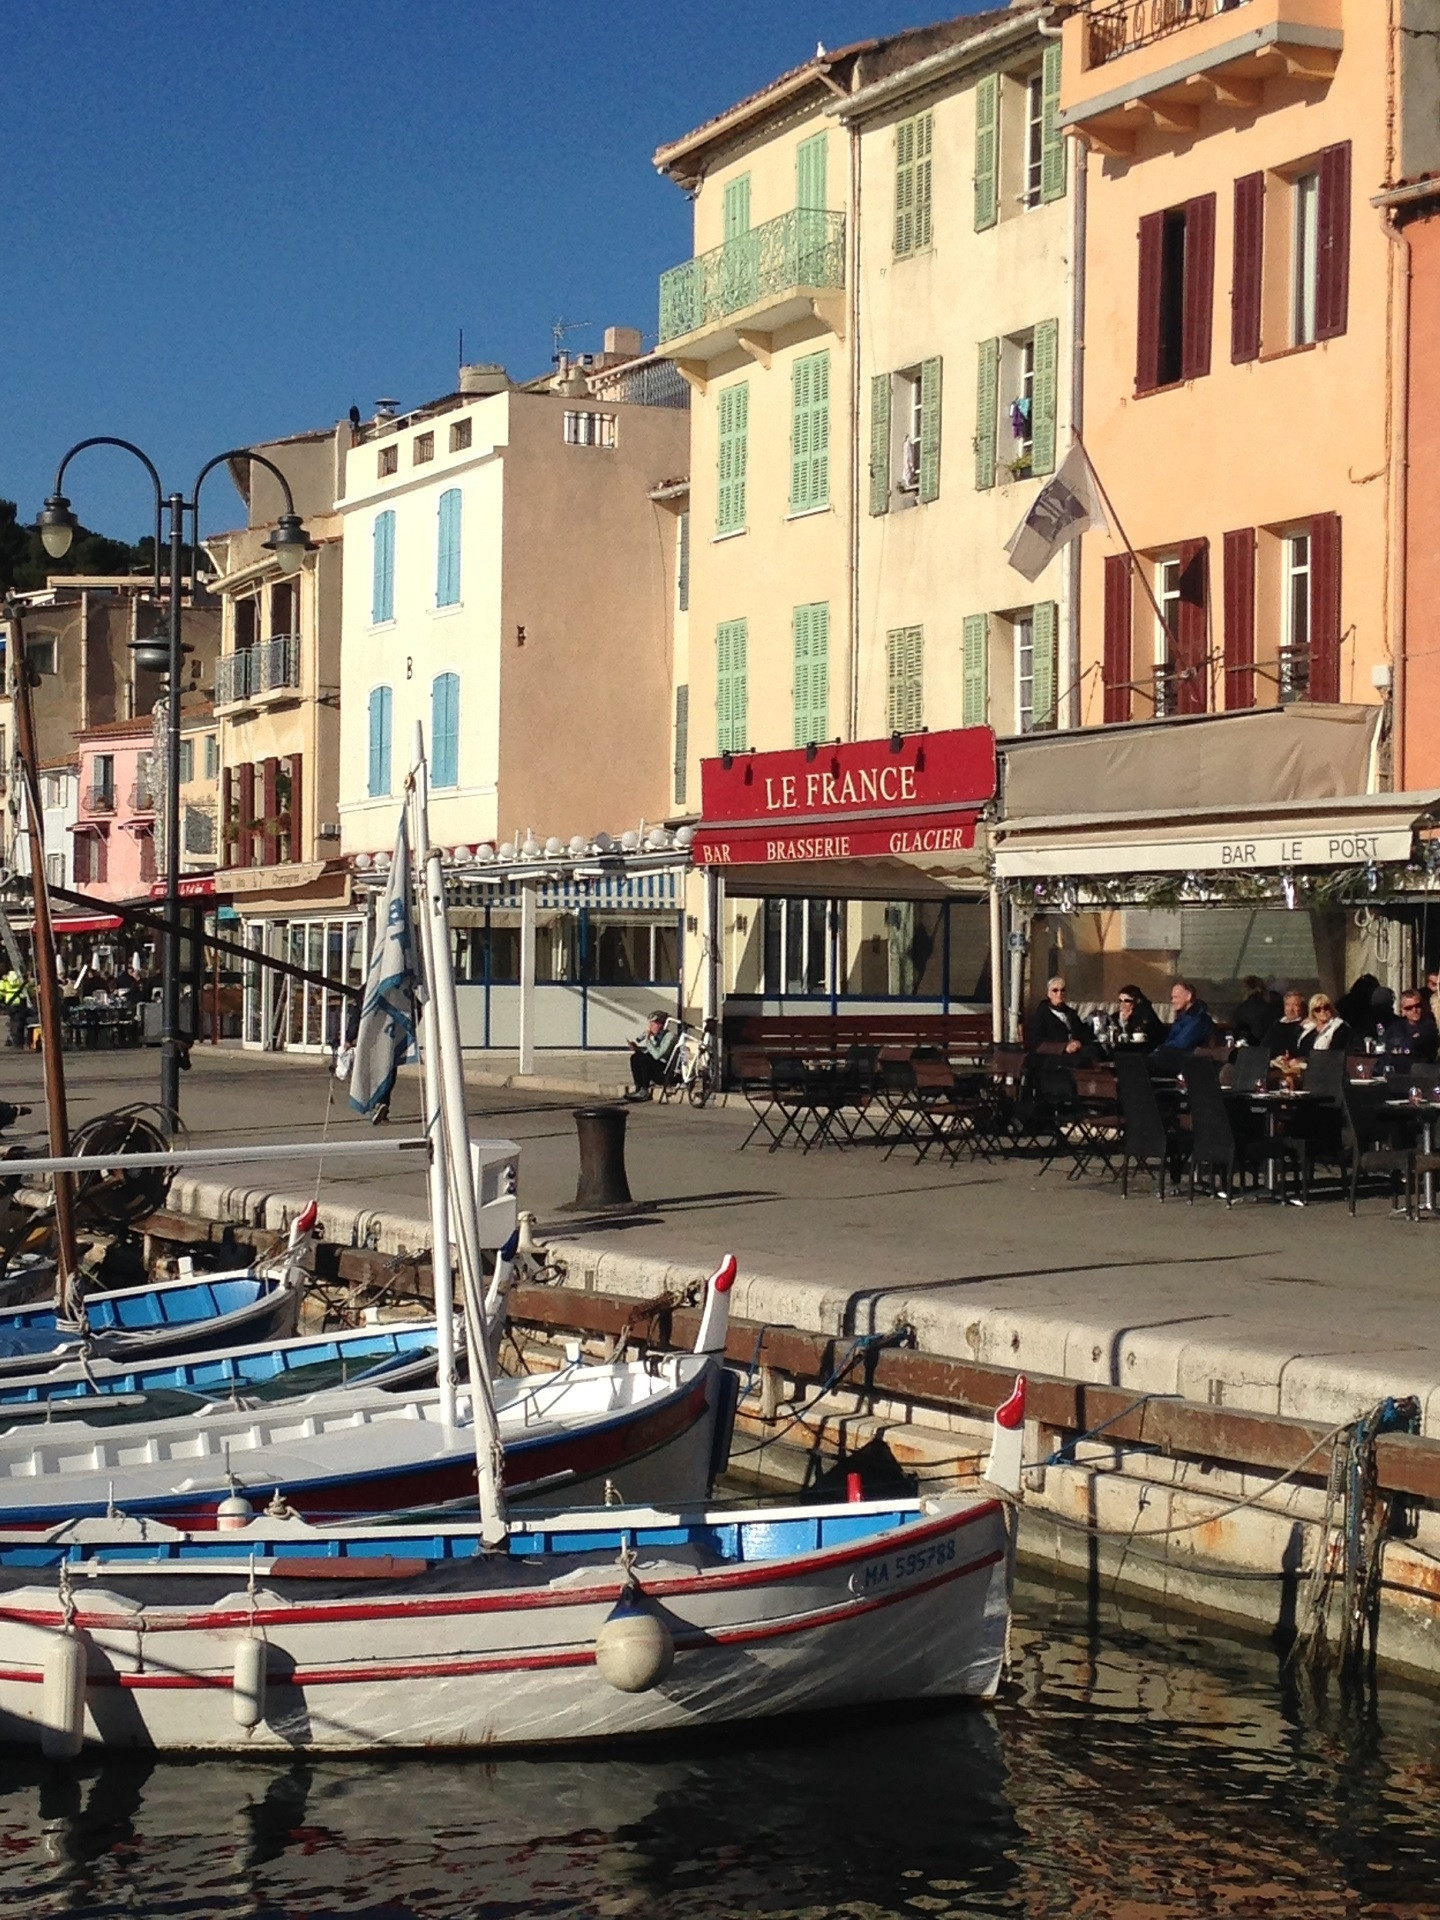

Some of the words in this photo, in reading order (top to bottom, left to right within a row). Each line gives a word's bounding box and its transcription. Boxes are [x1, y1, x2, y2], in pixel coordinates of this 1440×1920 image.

[765, 775, 797, 810] LE
[805, 765, 917, 807] FRANCE
[703, 844, 731, 863] BAR
[766, 836, 850, 861] BRASSERIE
[889, 828, 963, 853] GLACIER
[1221, 844, 1256, 865] BAR
[1281, 841, 1303, 861] LE
[1328, 837, 1379, 860] PORT
[865, 1563, 889, 1587] MA
